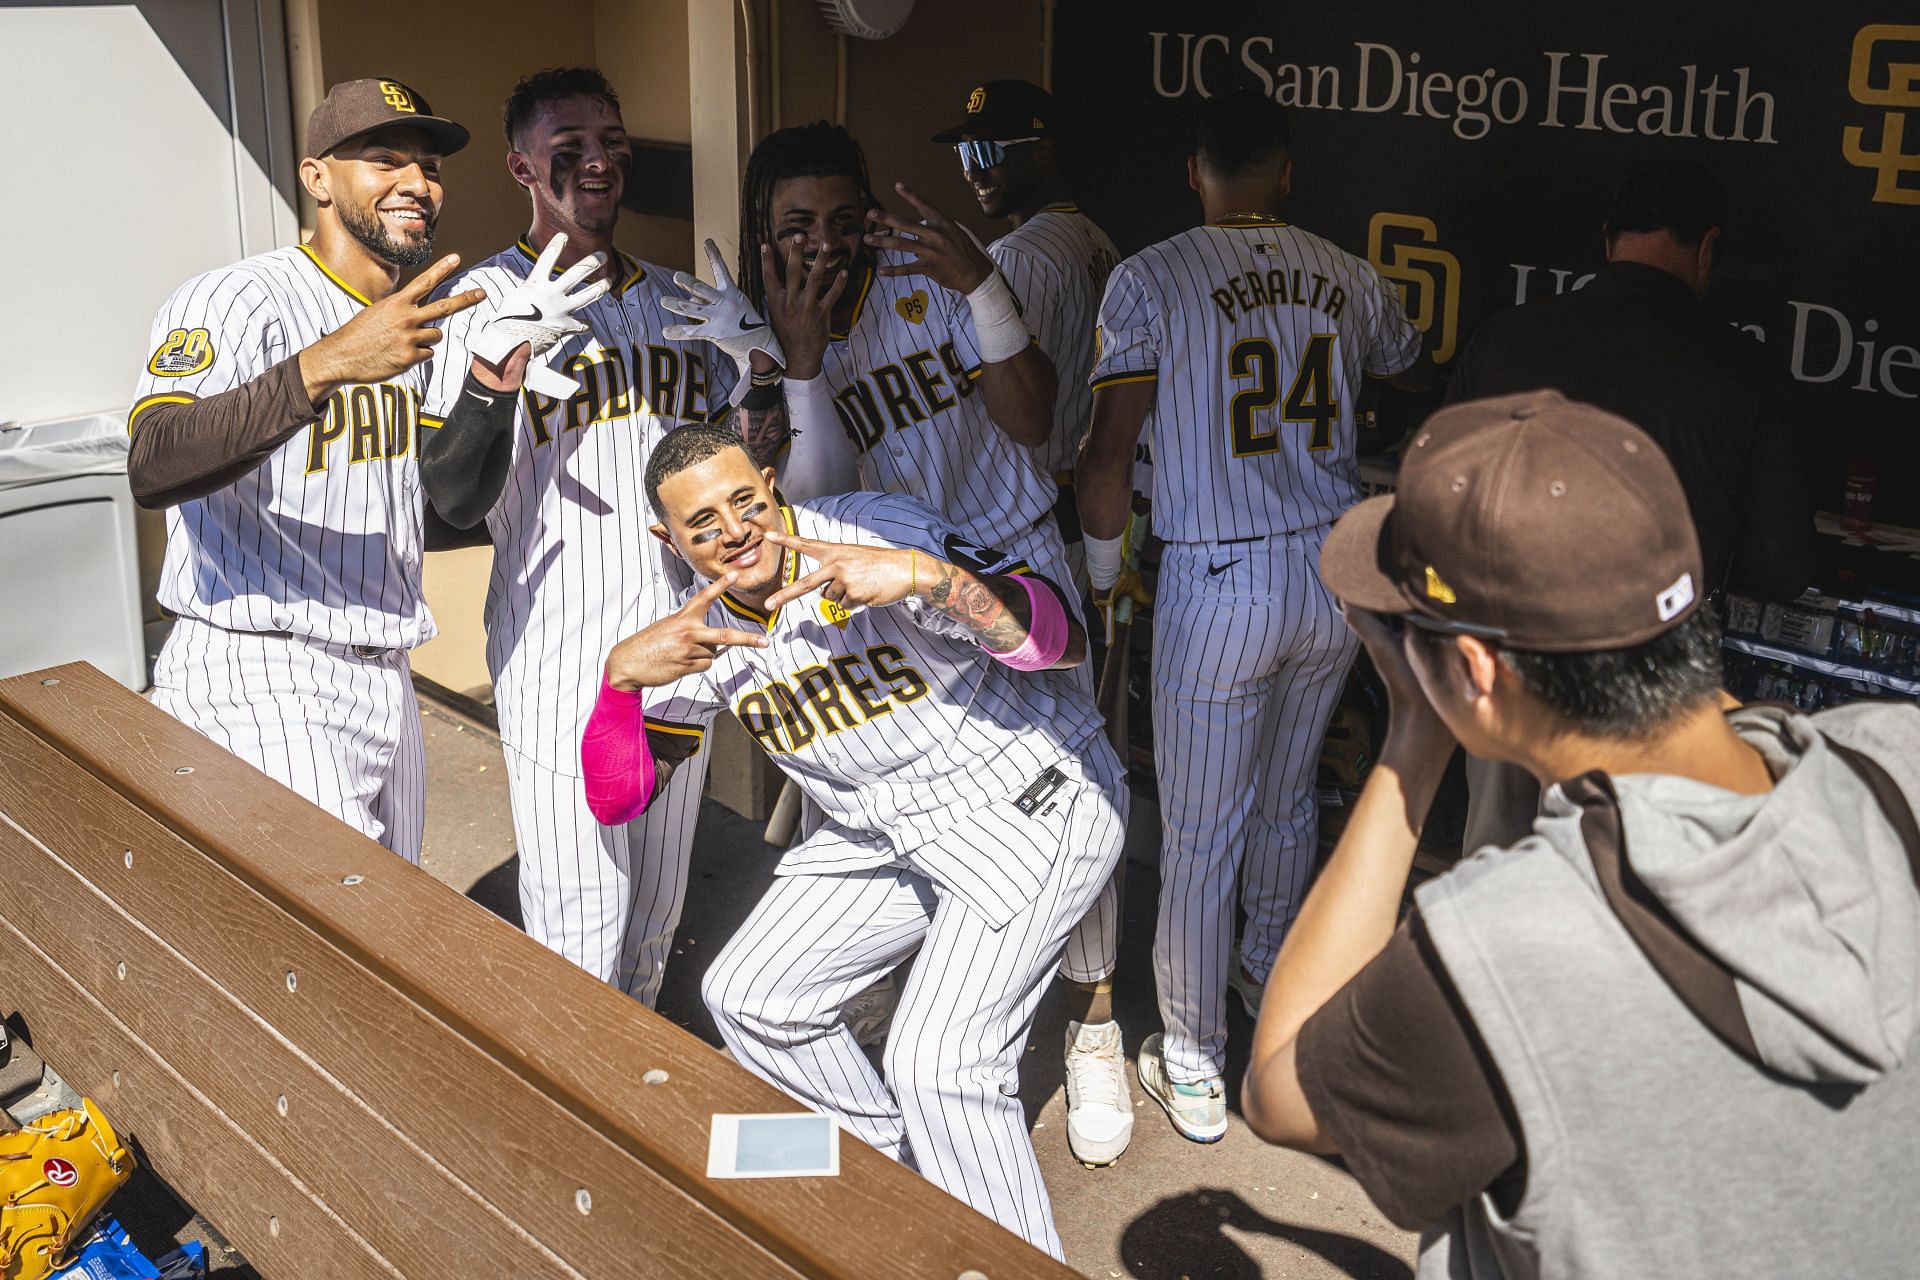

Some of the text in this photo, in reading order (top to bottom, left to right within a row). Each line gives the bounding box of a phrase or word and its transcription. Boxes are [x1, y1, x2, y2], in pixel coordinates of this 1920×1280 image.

[1149, 31, 1779, 145] UC San Diego Health
[904, 298, 923, 318] PS
[1210, 269, 1346, 324] PERALTA
[163, 328, 209, 358] 20
[304, 382, 420, 475] PAD
[1229, 333, 1339, 458] 24
